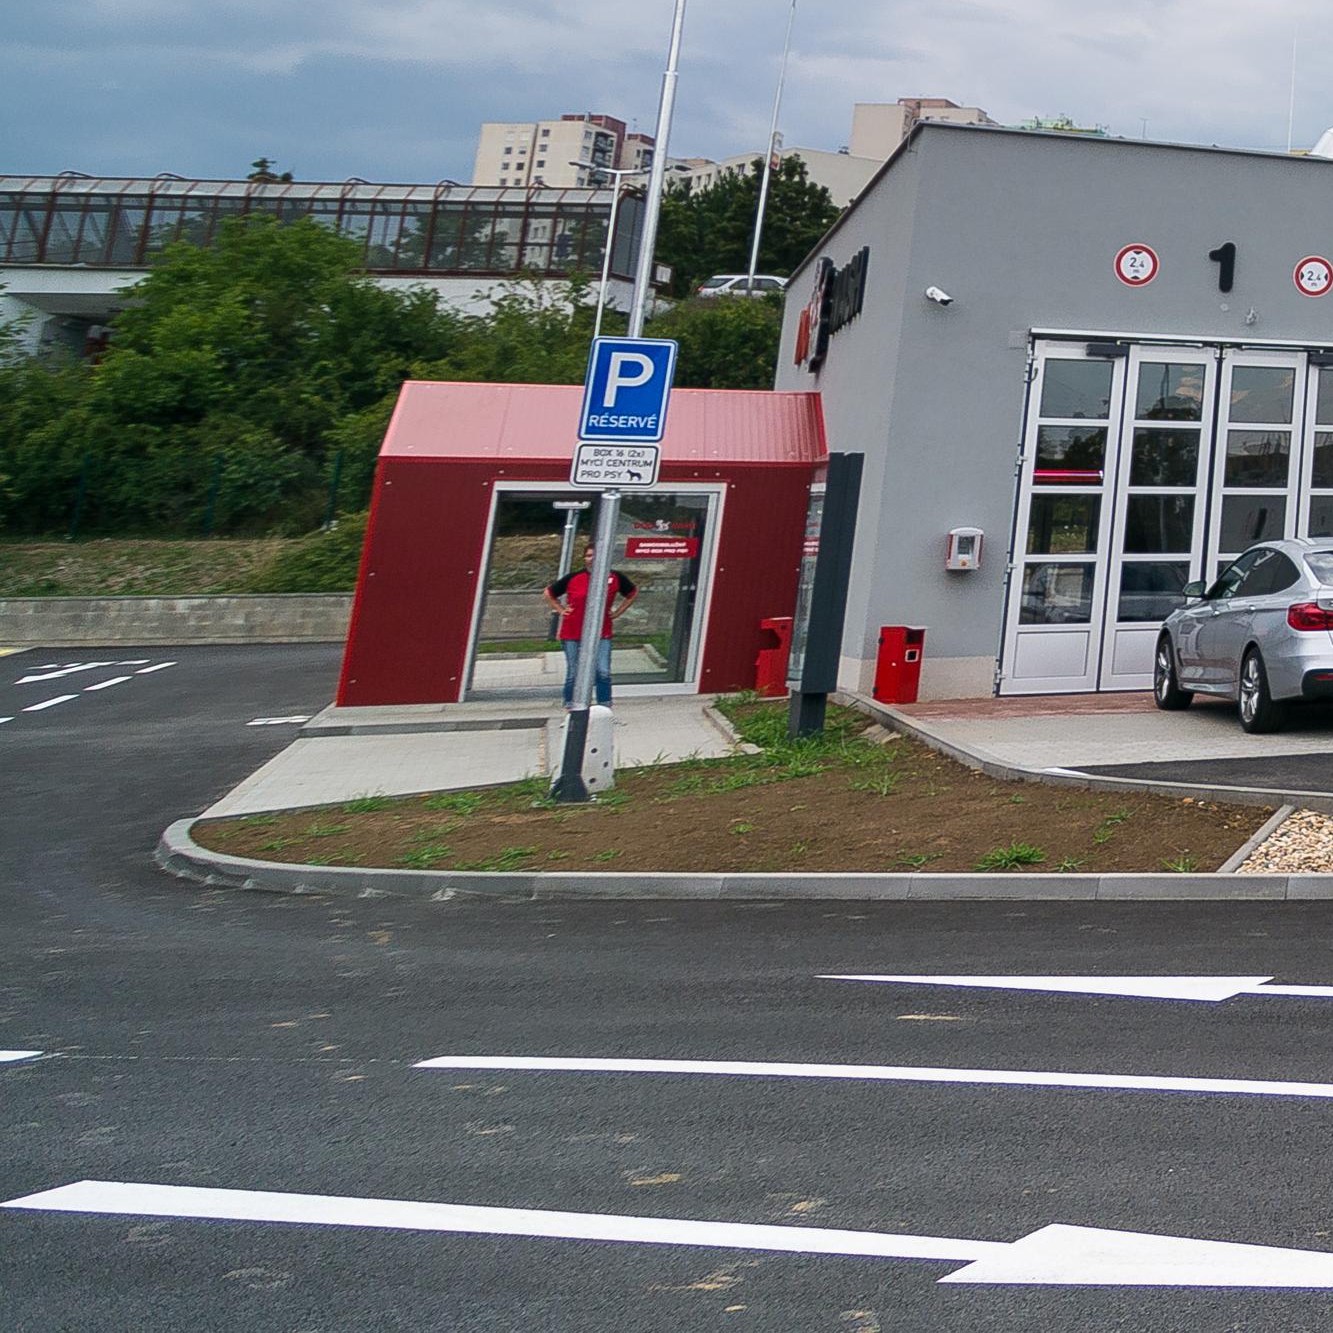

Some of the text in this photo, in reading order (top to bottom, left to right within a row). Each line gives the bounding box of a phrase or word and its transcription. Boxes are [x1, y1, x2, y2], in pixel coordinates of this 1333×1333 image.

[1208, 242, 1236, 294] 1
[603, 352, 655, 408] P
[588, 412, 658, 429] RÉSERVÉ
[593, 448, 613, 457] BOX
[605, 459, 653, 468] CENTRUM
[580, 470, 623, 479] PRO PSY
